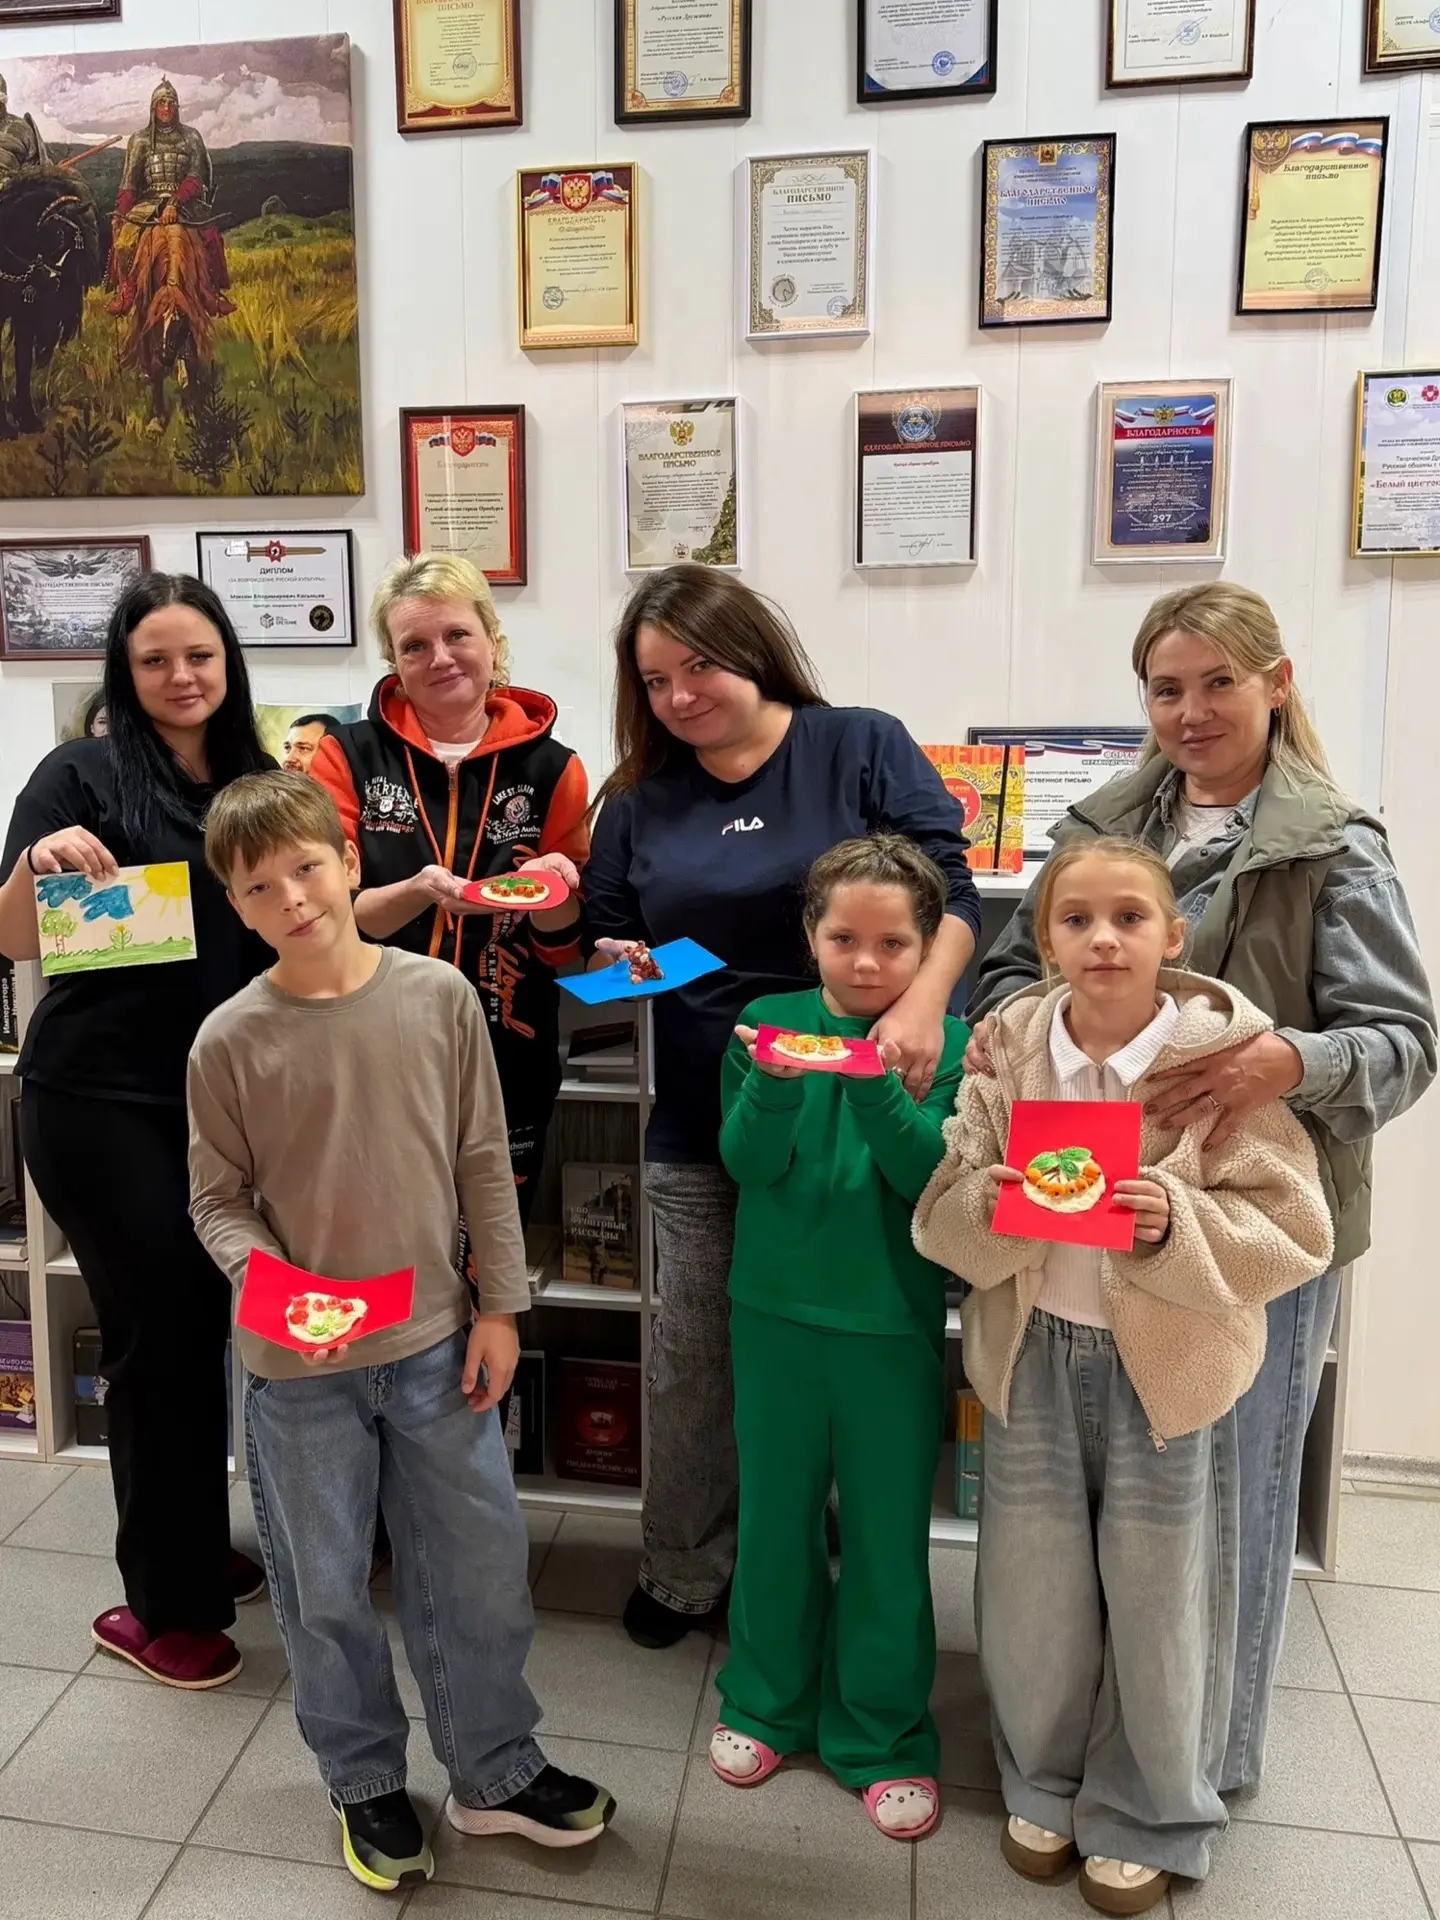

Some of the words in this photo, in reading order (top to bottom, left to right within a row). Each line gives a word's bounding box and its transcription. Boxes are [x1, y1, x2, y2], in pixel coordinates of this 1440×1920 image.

[438, 2, 474, 11] ПИСЬМО
[1284, 162, 1369, 173] Благодарственное
[773, 186, 845, 195] БЛАГОДАРСТВЕННОЕ
[1000, 186, 1096, 199] БЛАГОДАРСТВЕННОЕ
[787, 193, 832, 203] ПИСЬМО
[1027, 197, 1068, 207] ПИСЬМО
[1127, 428, 1201, 437] БЛАГОДАРНОСТЬ
[639, 450, 721, 461] БЛАГОДАРСТВЕННОЕ
[663, 460, 697, 468] ПИСЬМО
[1370, 480, 1406, 489] «Белый
[1153, 515, 1171, 523] 297
[492, 791, 507, 806] LAKE
[722, 817, 764, 836] FILA
[3, 978, 11, 1034] Императора
[510, 1140, 535, 1151] thority
[571, 1217, 628, 1231] ФРОНТОВЫЕ
[571, 1228, 619, 1241] РАССКАЗЫ
